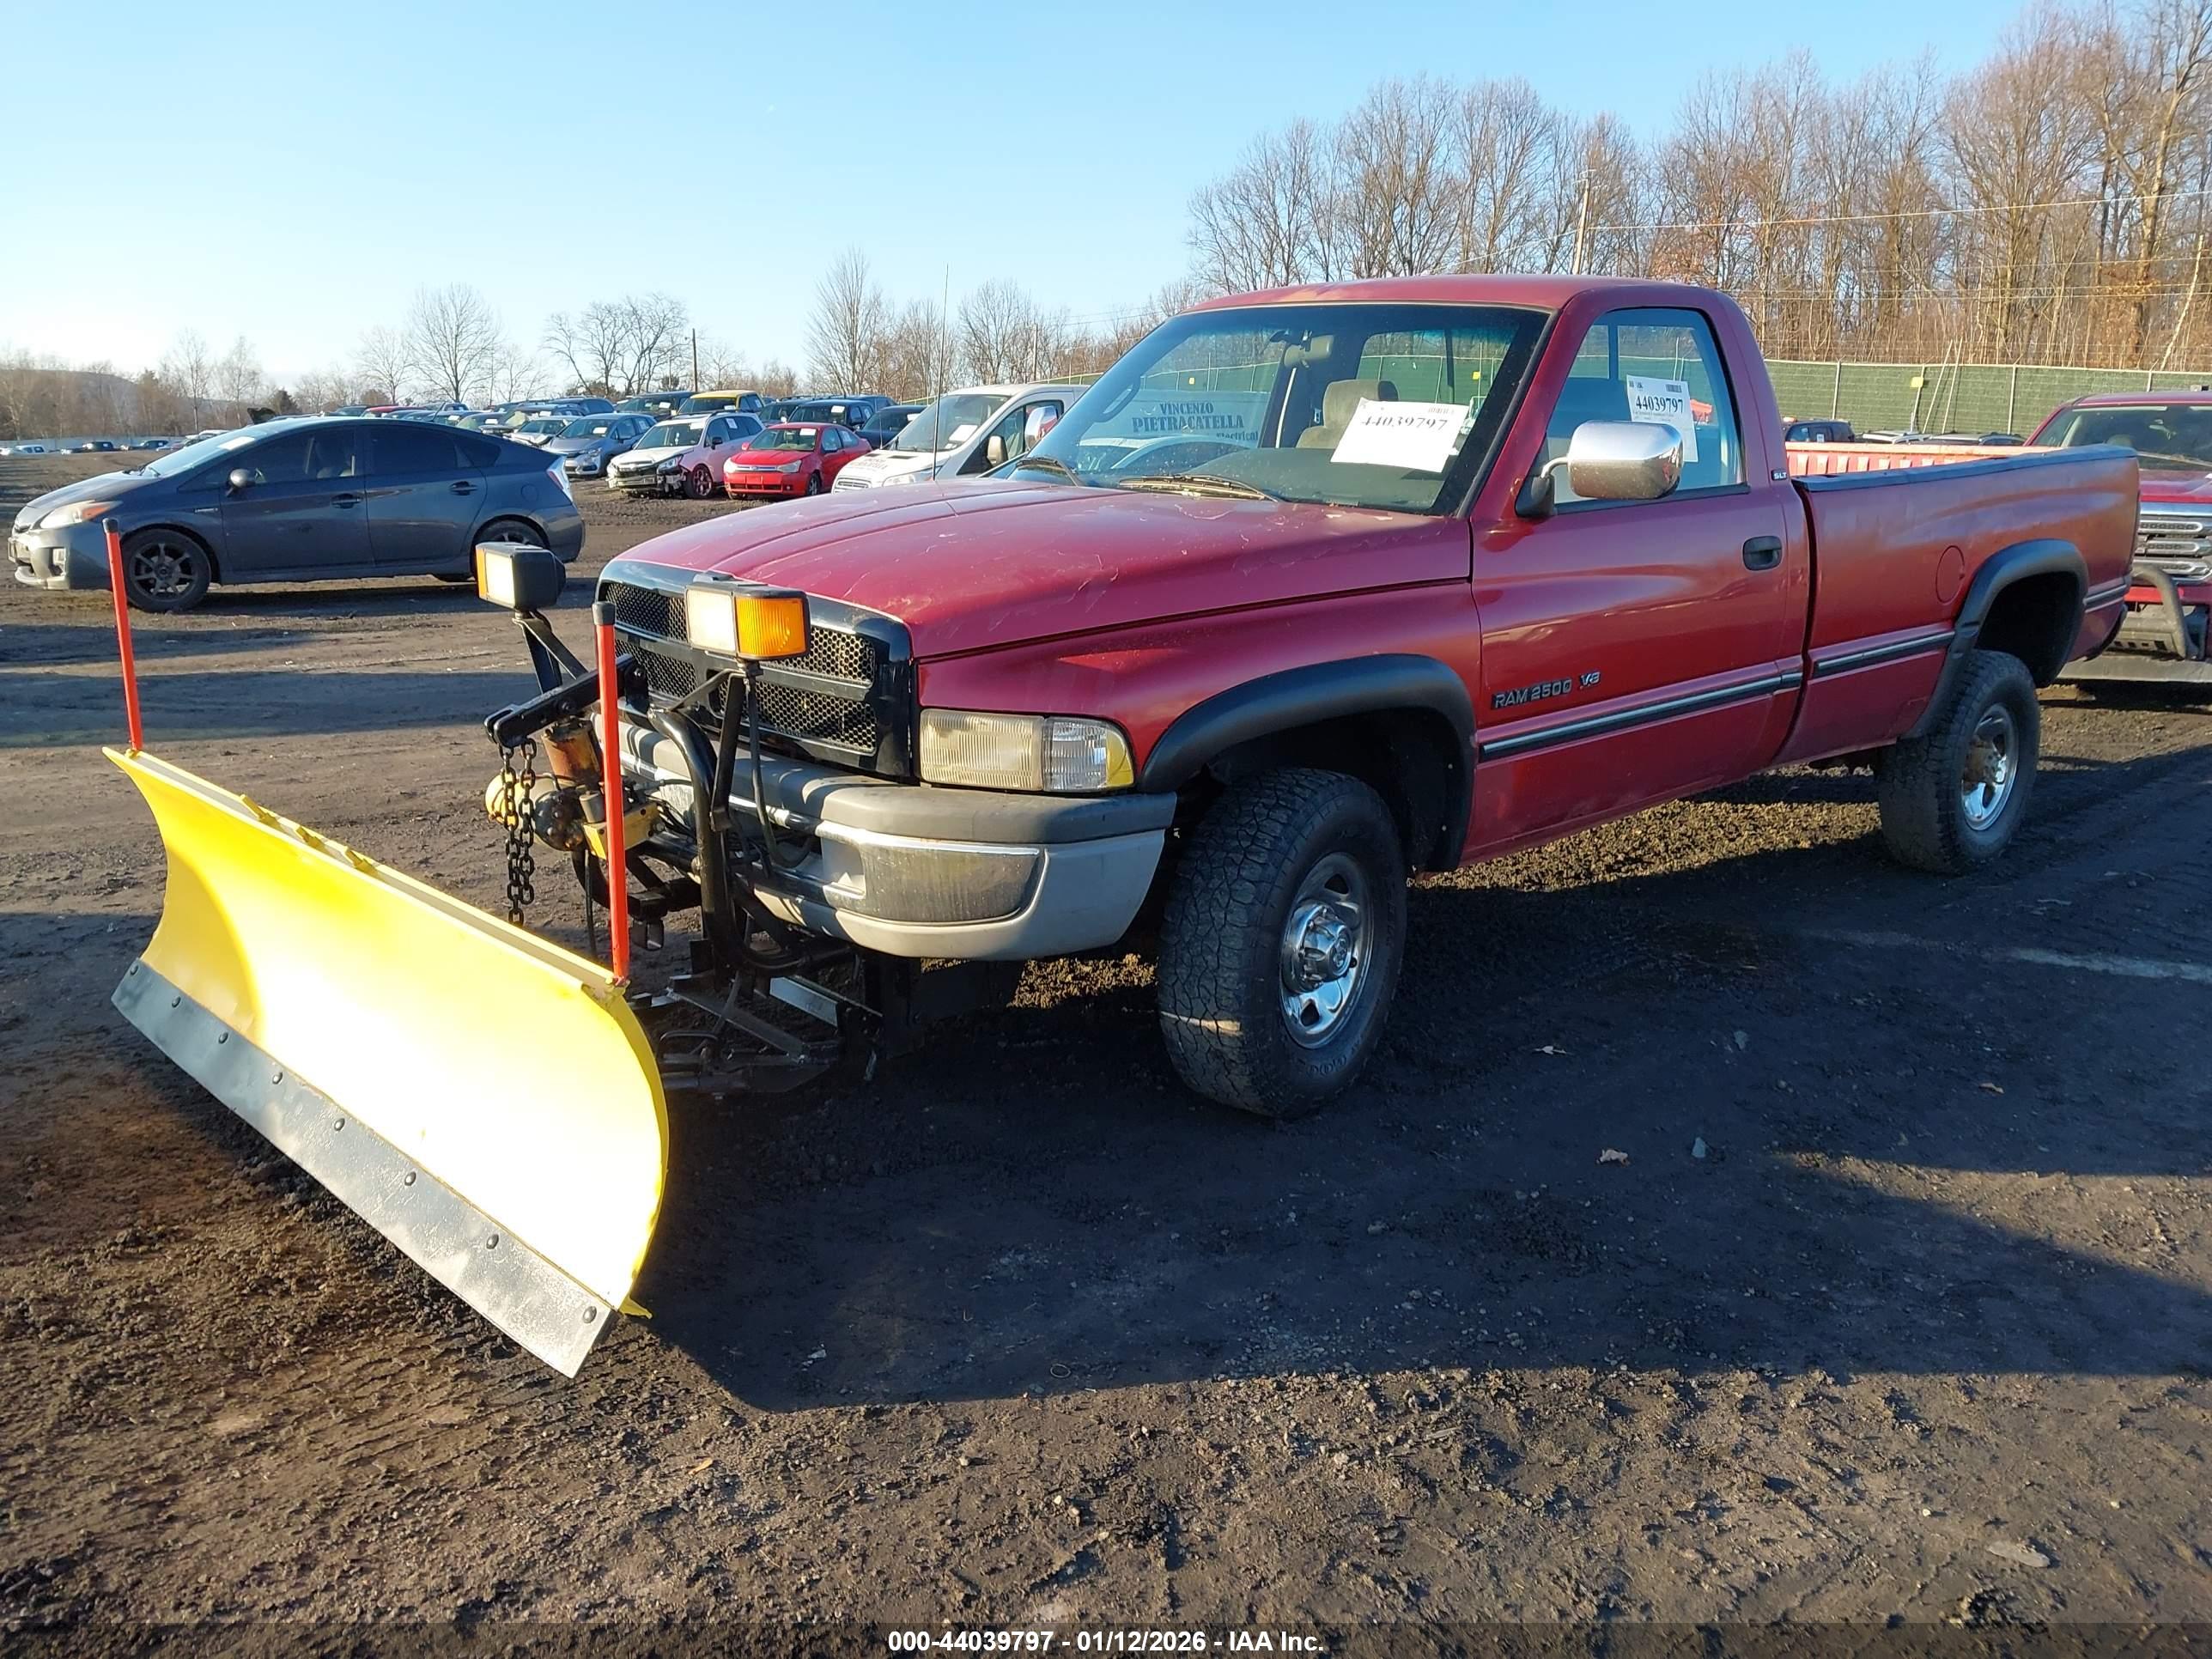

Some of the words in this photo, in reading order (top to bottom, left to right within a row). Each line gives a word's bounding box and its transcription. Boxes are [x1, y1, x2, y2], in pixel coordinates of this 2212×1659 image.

[1160, 402, 1214, 416] VINCENZO
[1636, 395, 1684, 414] 44039797
[1132, 415, 1244, 433] PIETRACATELLA
[1361, 415, 1449, 431] 44039797
[1773, 471, 1787, 480] SLT
[1494, 688, 1528, 708] RAM
[1530, 678, 1572, 701] 2500
[1580, 671, 1601, 686] V8
